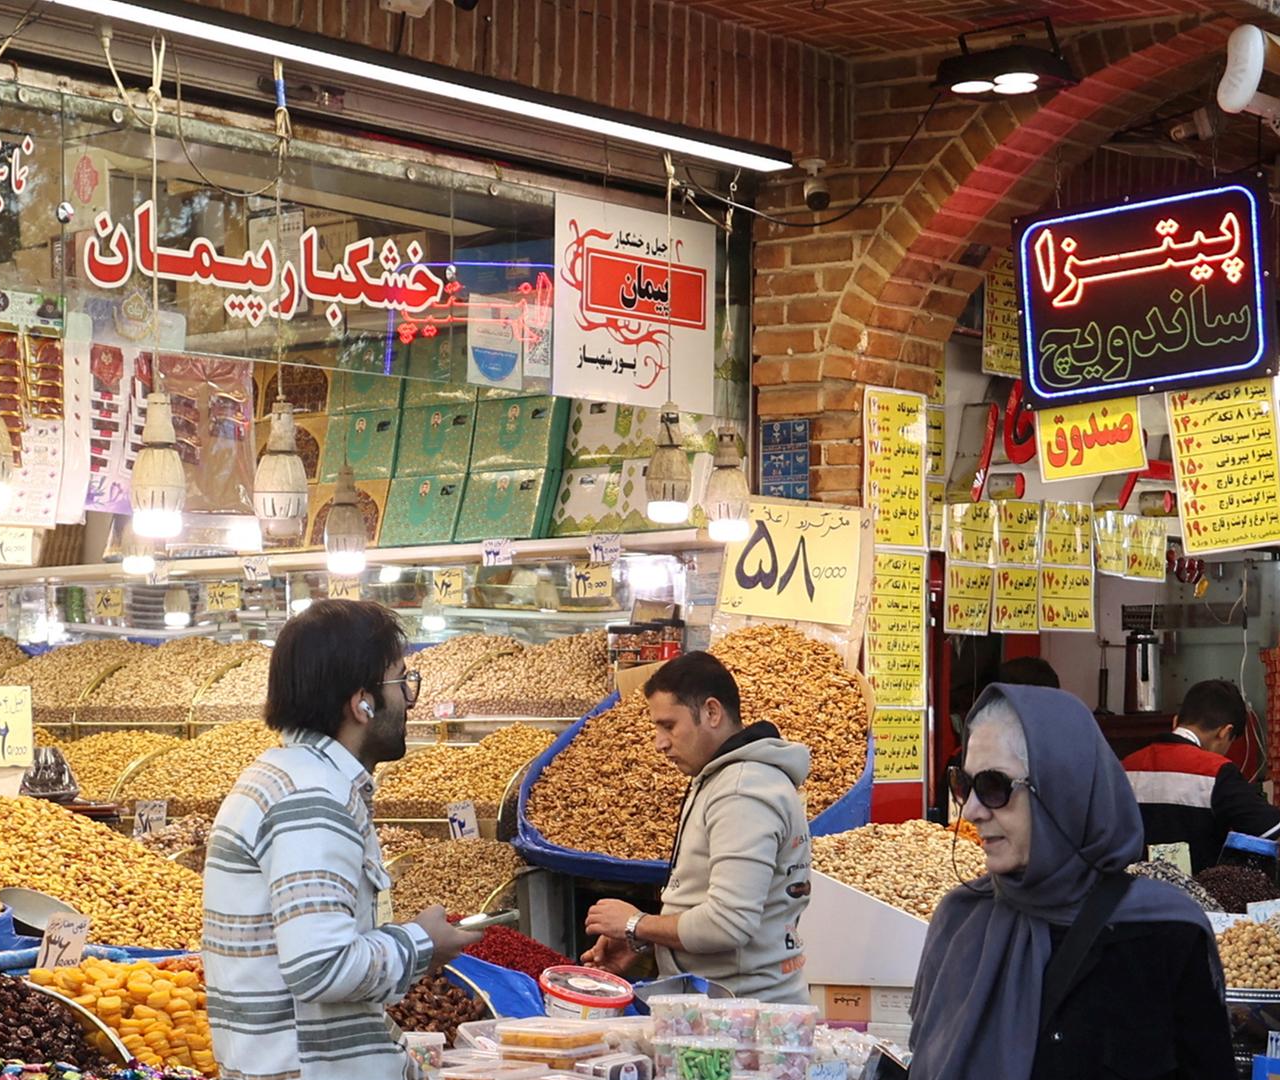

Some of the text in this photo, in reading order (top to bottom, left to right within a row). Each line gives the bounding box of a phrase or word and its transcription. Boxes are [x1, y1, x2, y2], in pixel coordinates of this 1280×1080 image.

[1033, 210, 1247, 310] پیتزا
[620, 264, 673, 317] پیمان
[1038, 283, 1253, 390] ساندویچ
[1047, 407, 1135, 469] صندوق
[1174, 416, 1200, 433] ۱۴۰
[1177, 437, 1204, 455] ۱۳۰
